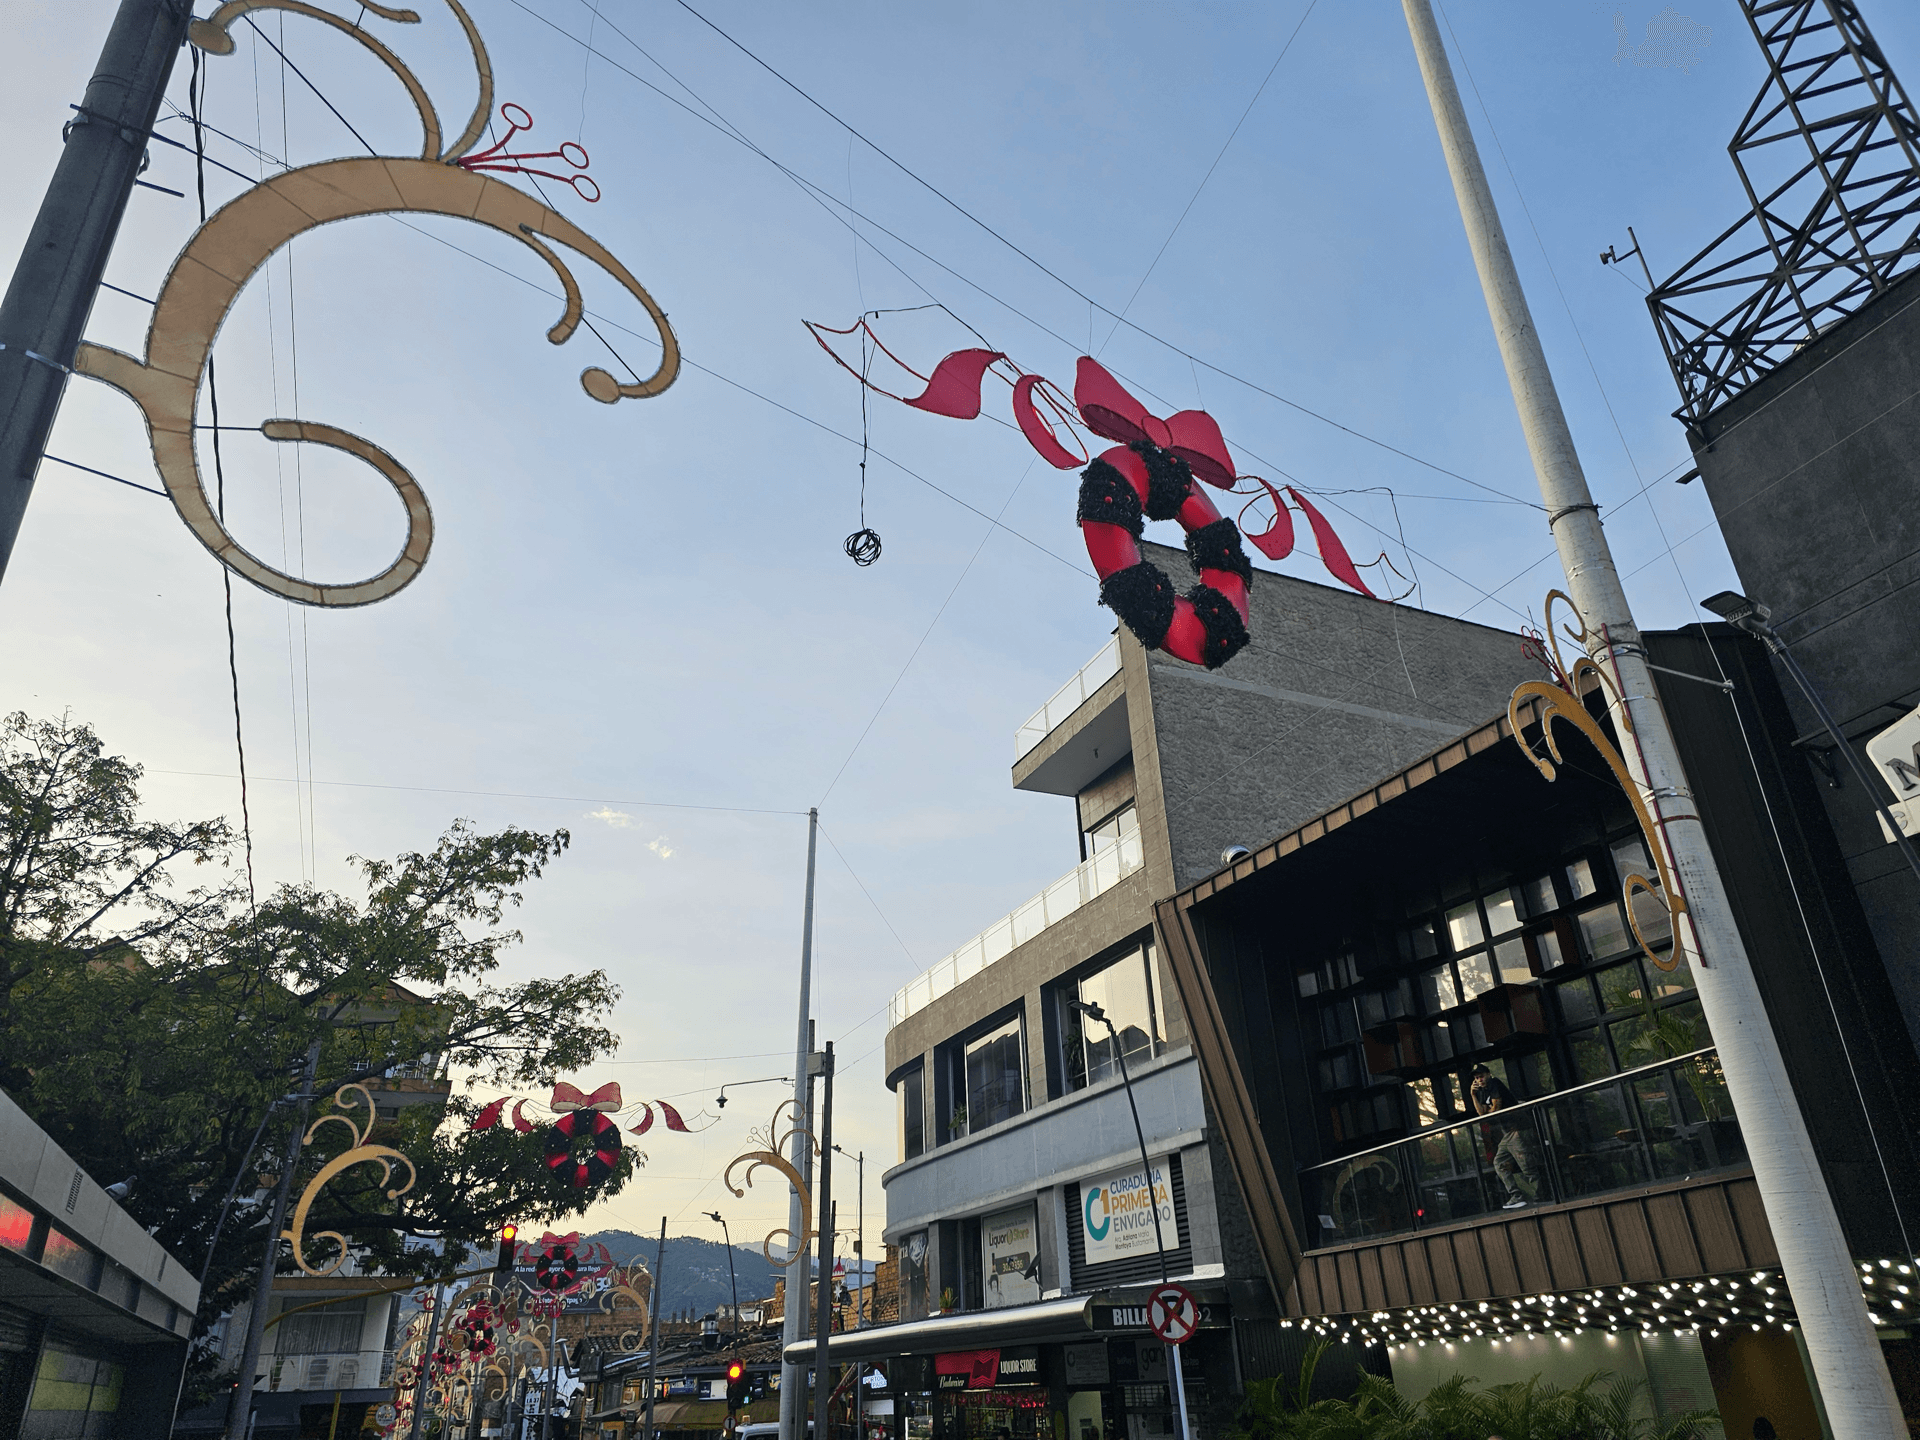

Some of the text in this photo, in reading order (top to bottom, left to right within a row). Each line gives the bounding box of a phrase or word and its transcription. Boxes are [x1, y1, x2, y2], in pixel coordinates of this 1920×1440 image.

[989, 1232, 1006, 1248] Liquor
[1000, 1358, 1037, 1374] LIQUOR STORE
[938, 1375, 965, 1388] Budweiser
